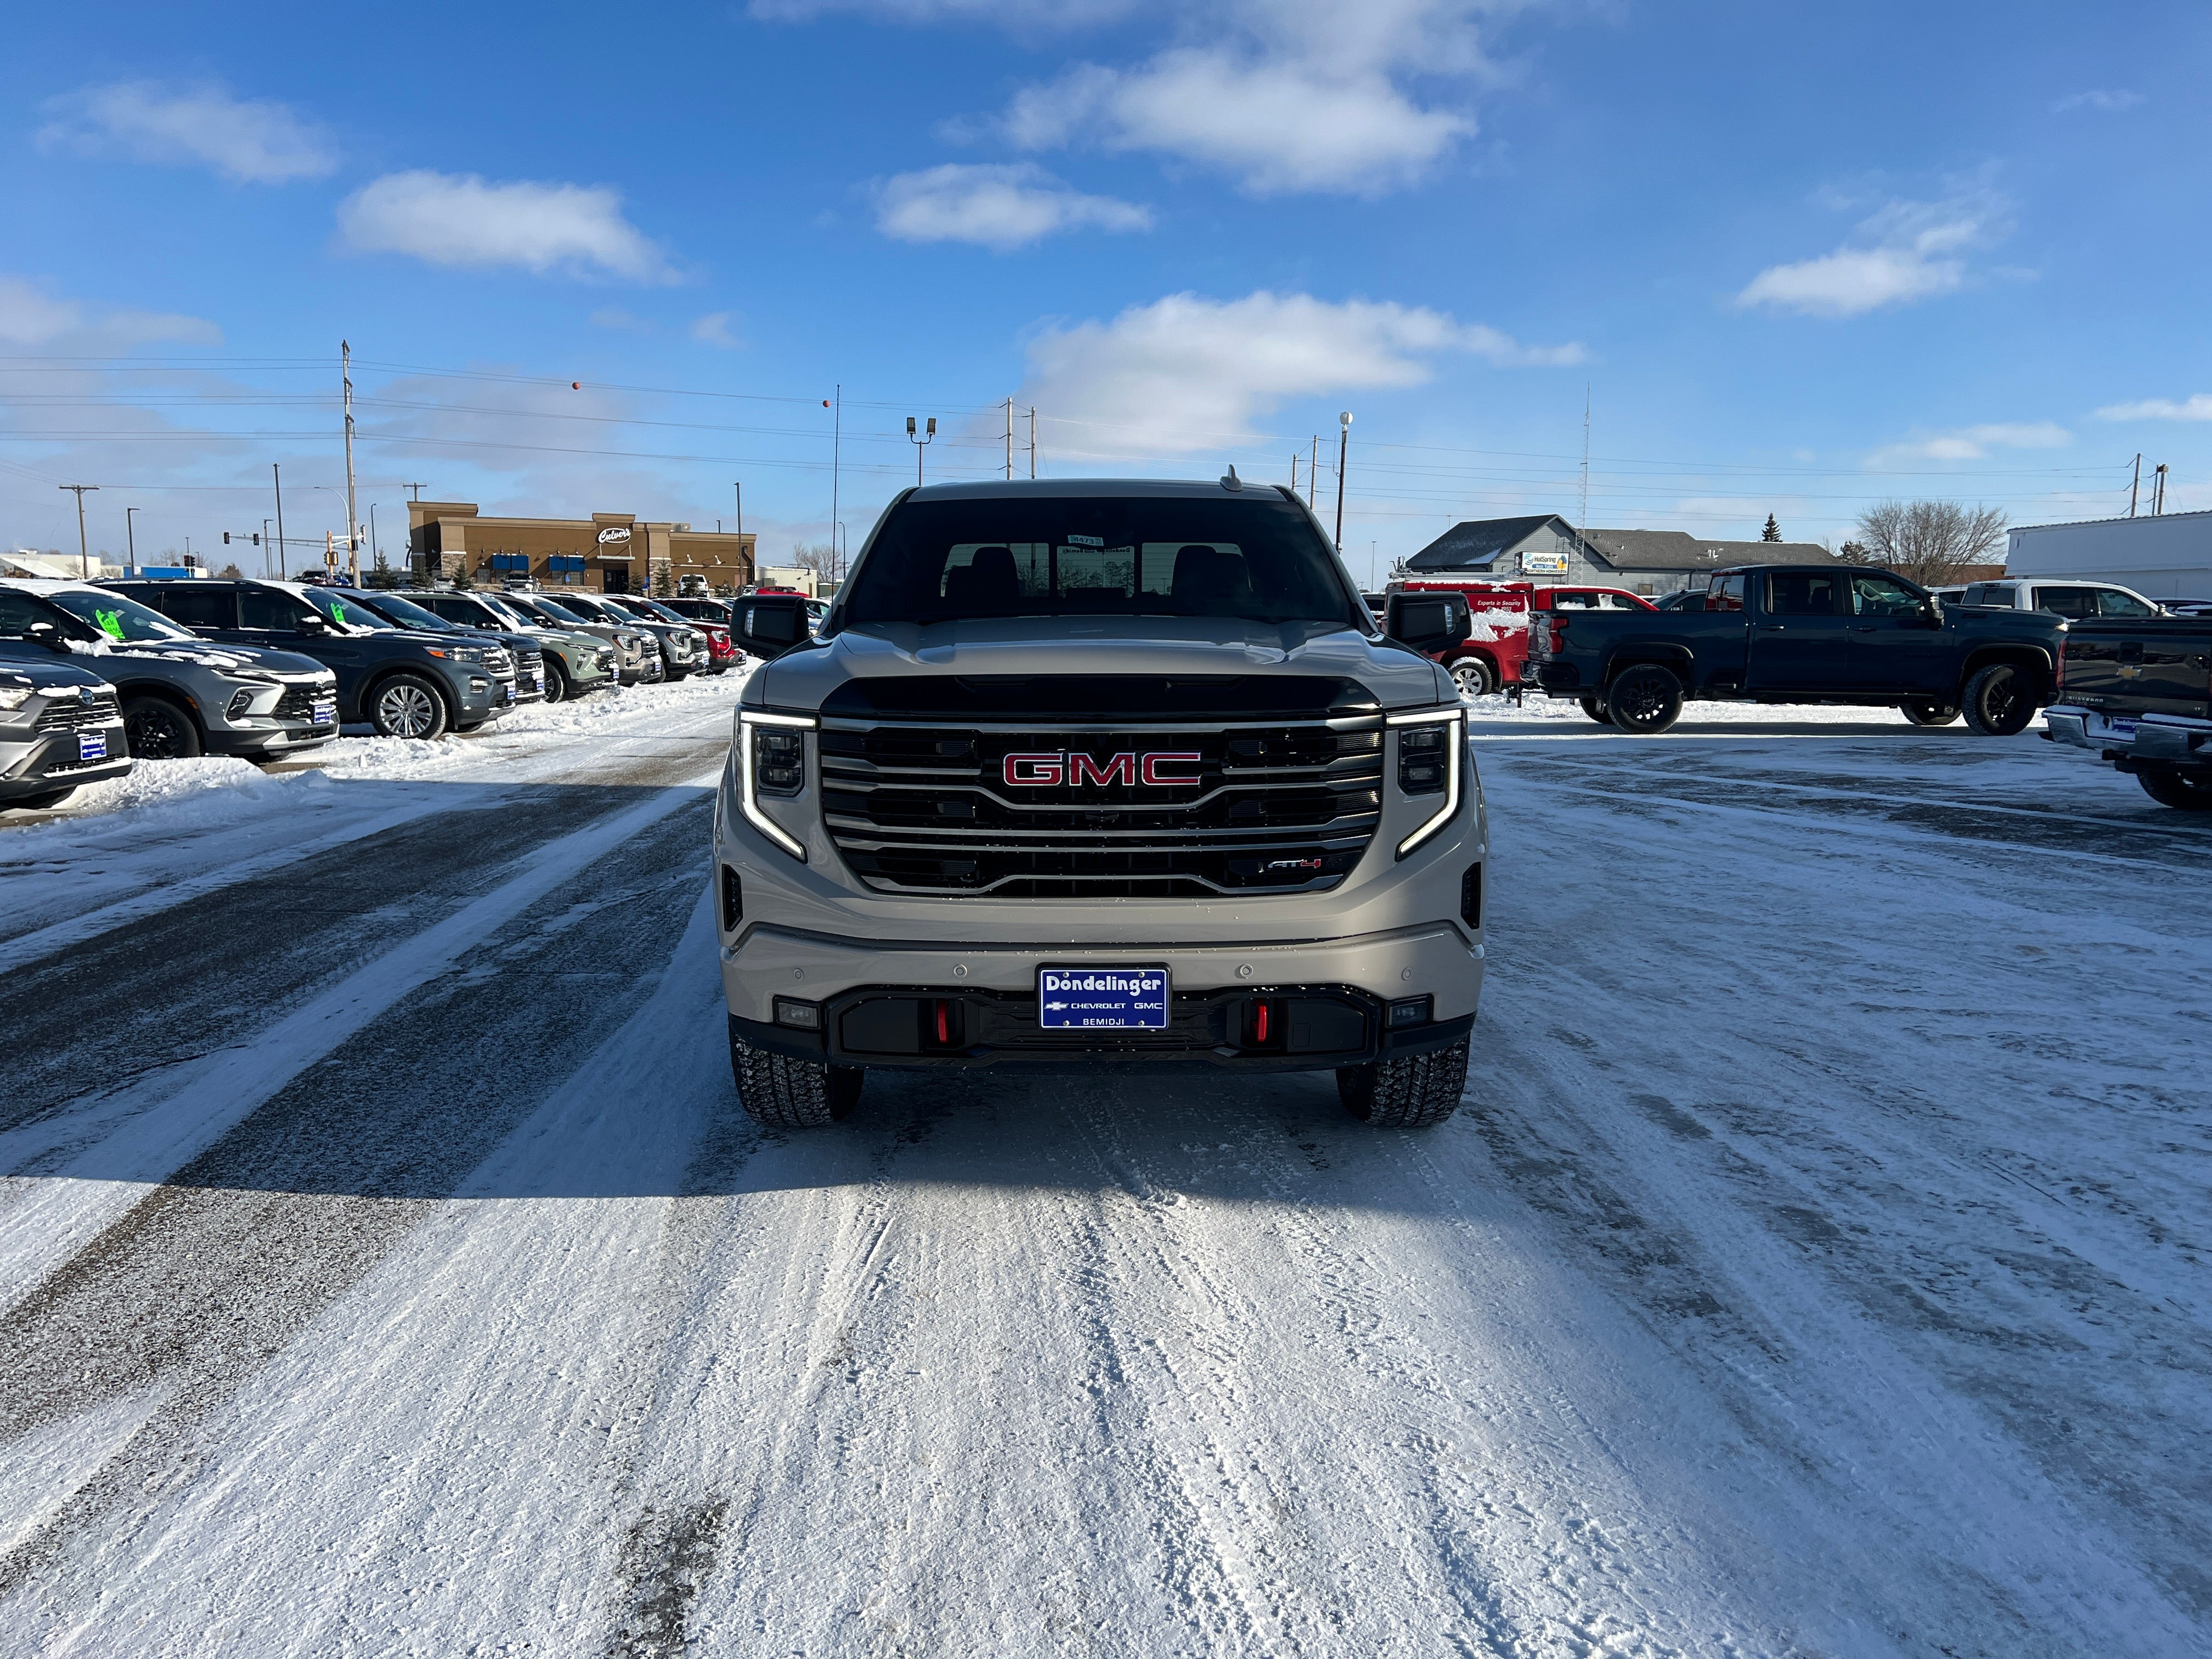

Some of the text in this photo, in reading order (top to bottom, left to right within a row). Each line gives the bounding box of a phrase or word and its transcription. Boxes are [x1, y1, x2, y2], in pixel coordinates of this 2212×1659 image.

[598, 528, 631, 543] Culver's
[1074, 537, 1094, 545] 4473
[1003, 752, 1201, 786] GMC
[1268, 859, 1321, 869] AT4
[1046, 975, 1161, 996] Dondelinger
